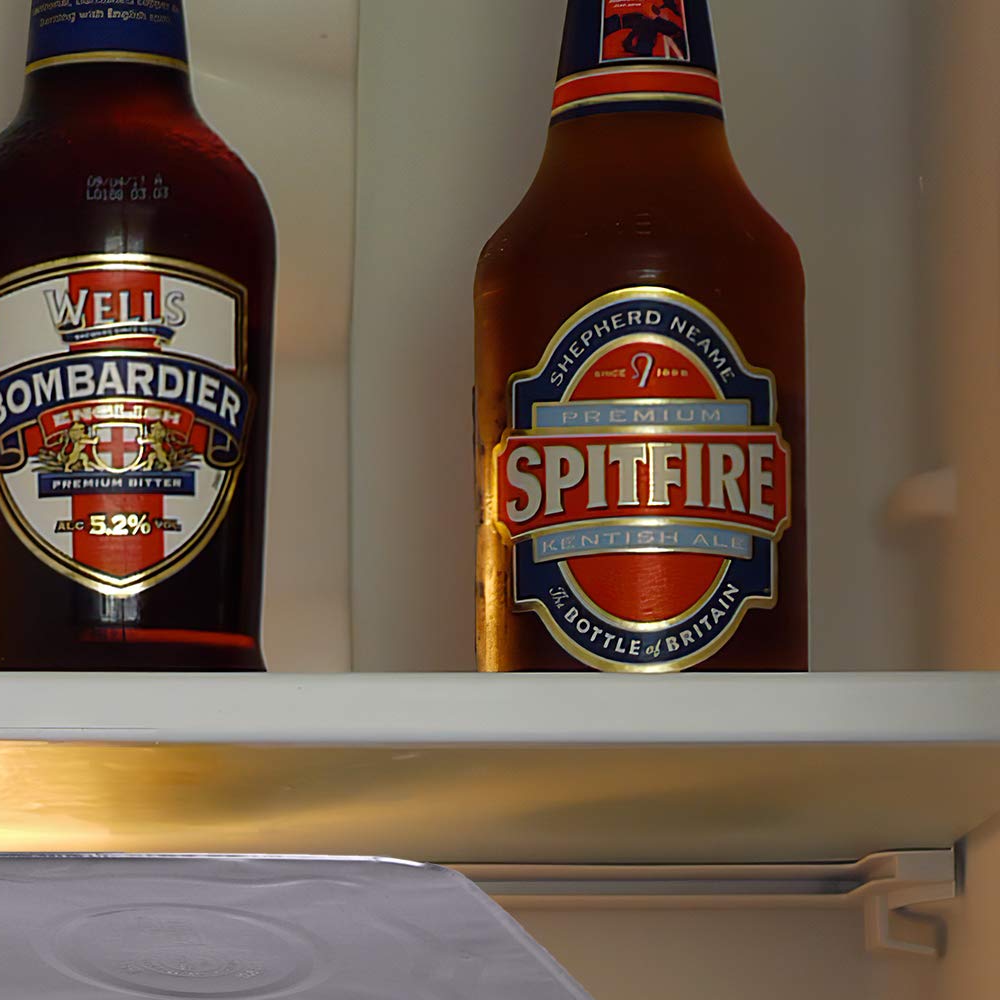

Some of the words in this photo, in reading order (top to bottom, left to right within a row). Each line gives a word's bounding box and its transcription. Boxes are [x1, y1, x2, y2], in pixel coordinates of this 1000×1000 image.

[44, 289, 187, 327] WELLS
[551, 310, 661, 387] SHEPHERD
[670, 316, 735, 384] NEAME
[52, 403, 181, 427] ENGLISH
[562, 409, 721, 423] PREMIUM
[52, 479, 122, 489] PREMIUM
[128, 477, 182, 488] BITTER
[506, 443, 774, 523] SPITFIRE
[57, 521, 85, 531] ALC
[89, 514, 151, 535] 5.2%
[542, 531, 678, 553] KENTISH
[692, 534, 746, 550] ALE
[549, 586, 569, 609] The
[564, 606, 641, 655] BOTTLE
[645, 639, 662, 657] of
[666, 583, 740, 653] BRITAIN
